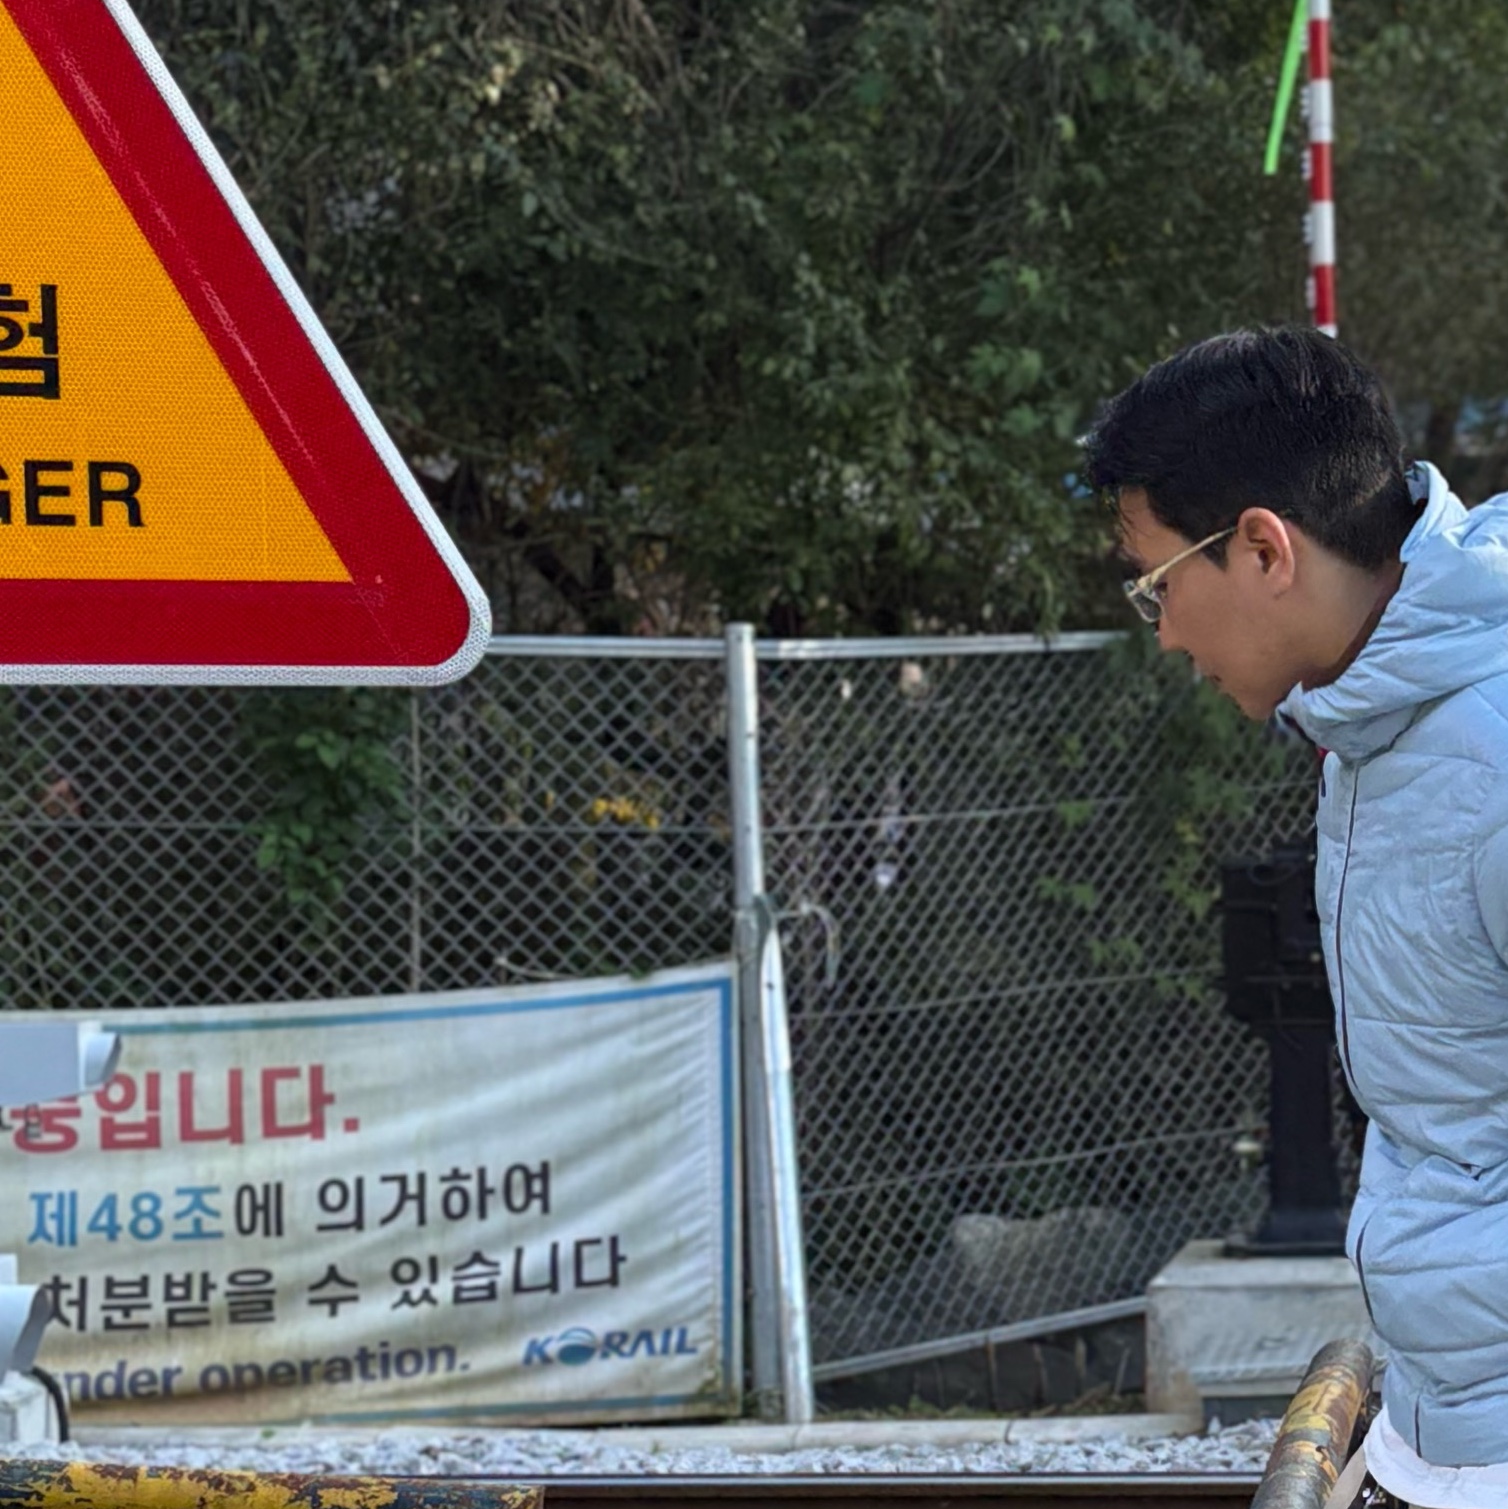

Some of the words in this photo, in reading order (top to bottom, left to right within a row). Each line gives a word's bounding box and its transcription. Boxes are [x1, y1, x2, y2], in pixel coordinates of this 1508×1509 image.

[0, 459, 145, 527] ER
[27, 1181, 285, 1247] 제48조에
[315, 1160, 551, 1233] 의거하여
[44, 1267, 277, 1332] 처분받을
[307, 1263, 360, 1318] 수
[390, 1235, 628, 1311] 있습니다
[54, 1360, 183, 1400] nder
[198, 1340, 471, 1399] operation.
[521, 1325, 698, 1367] KORAIL
